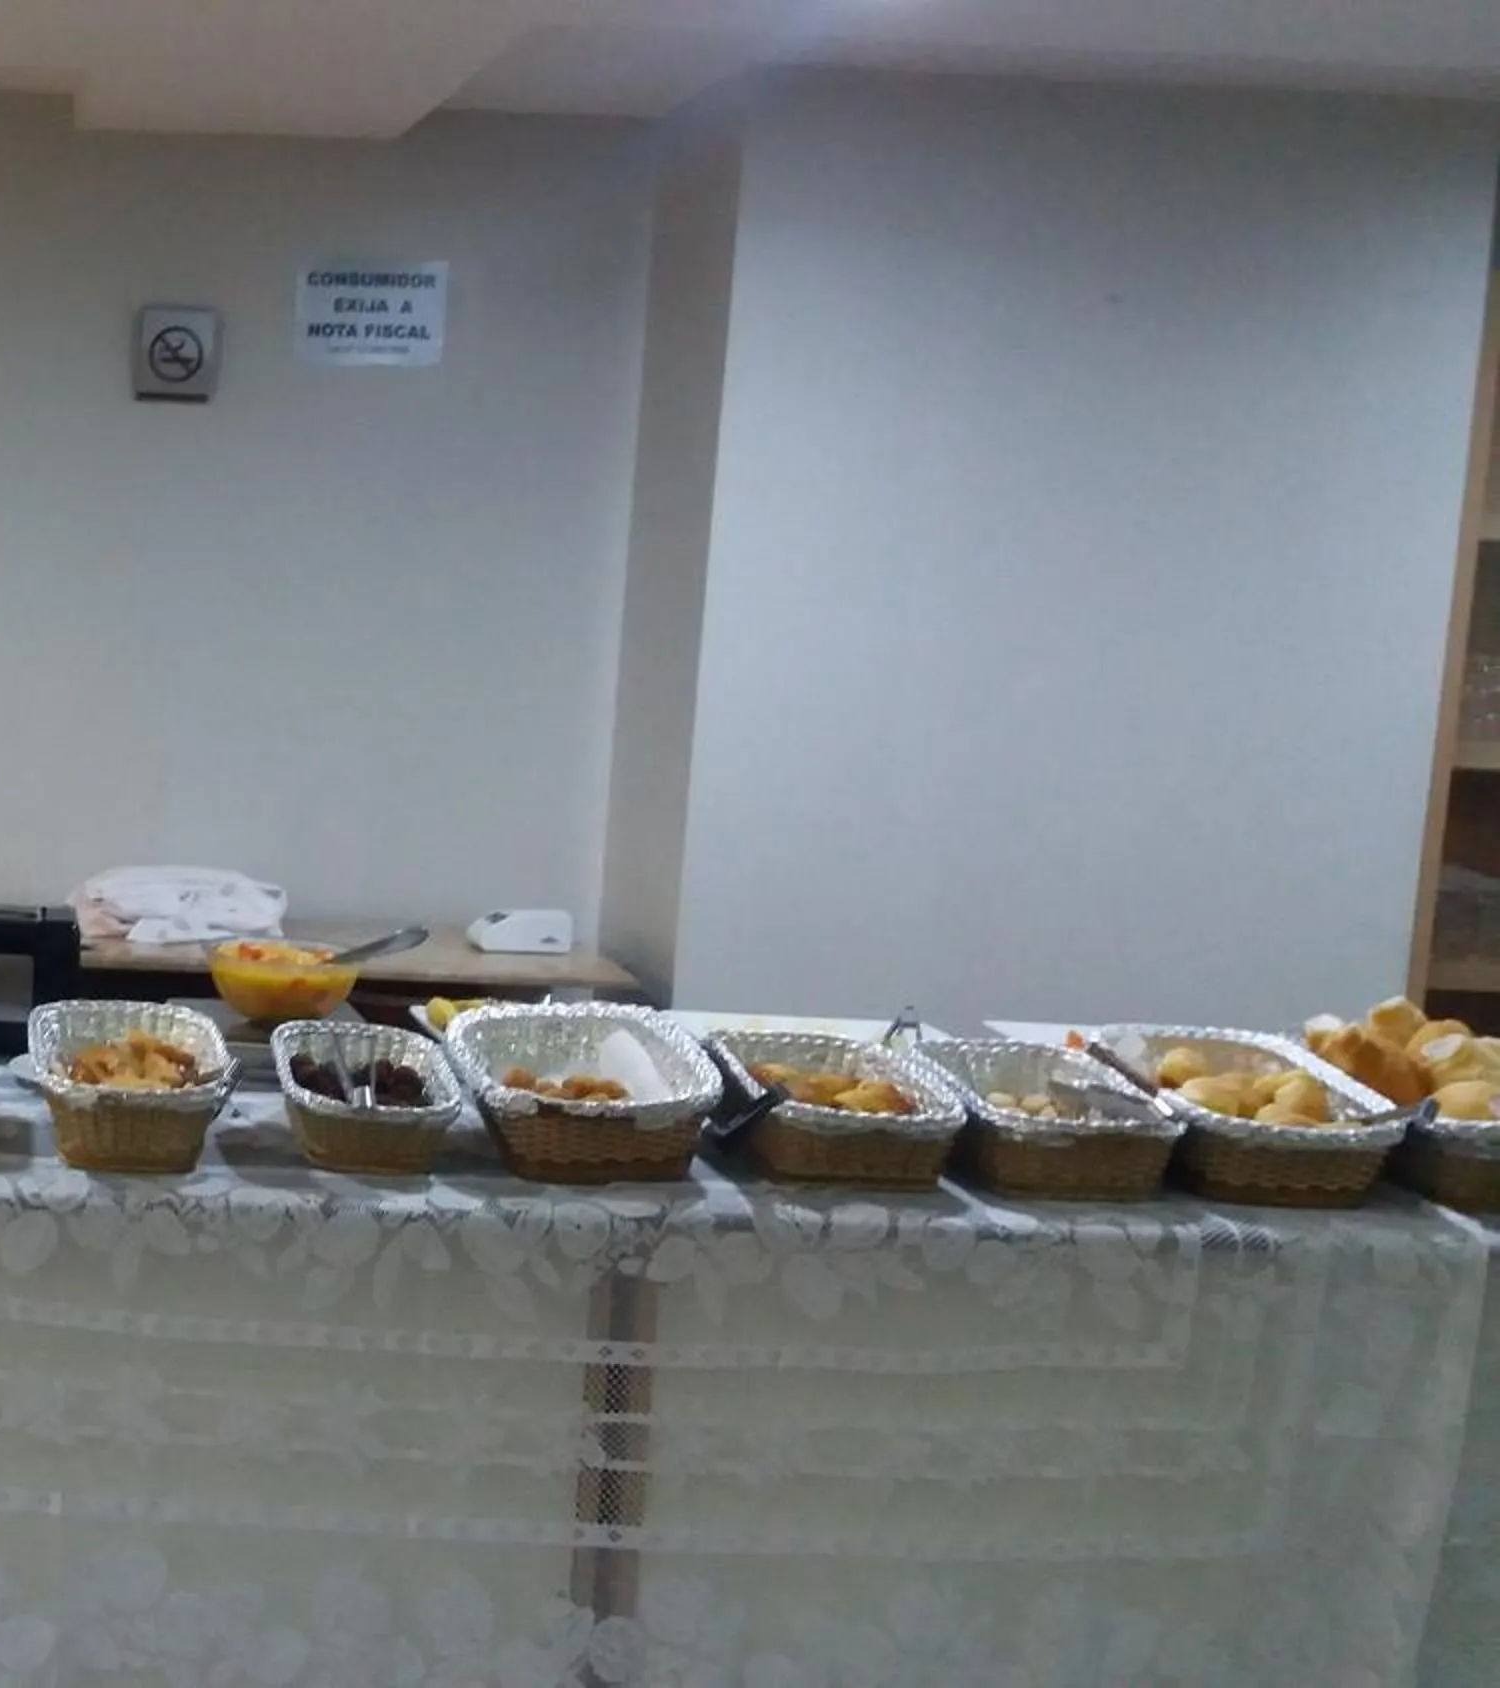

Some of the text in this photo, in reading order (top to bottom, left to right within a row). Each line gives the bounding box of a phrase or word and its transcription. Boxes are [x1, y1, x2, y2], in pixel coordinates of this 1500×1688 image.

[308, 271, 436, 288] CONSUMIDOR
[334, 298, 413, 314] EXIJA A
[308, 323, 431, 340] NOTA FISCAL
